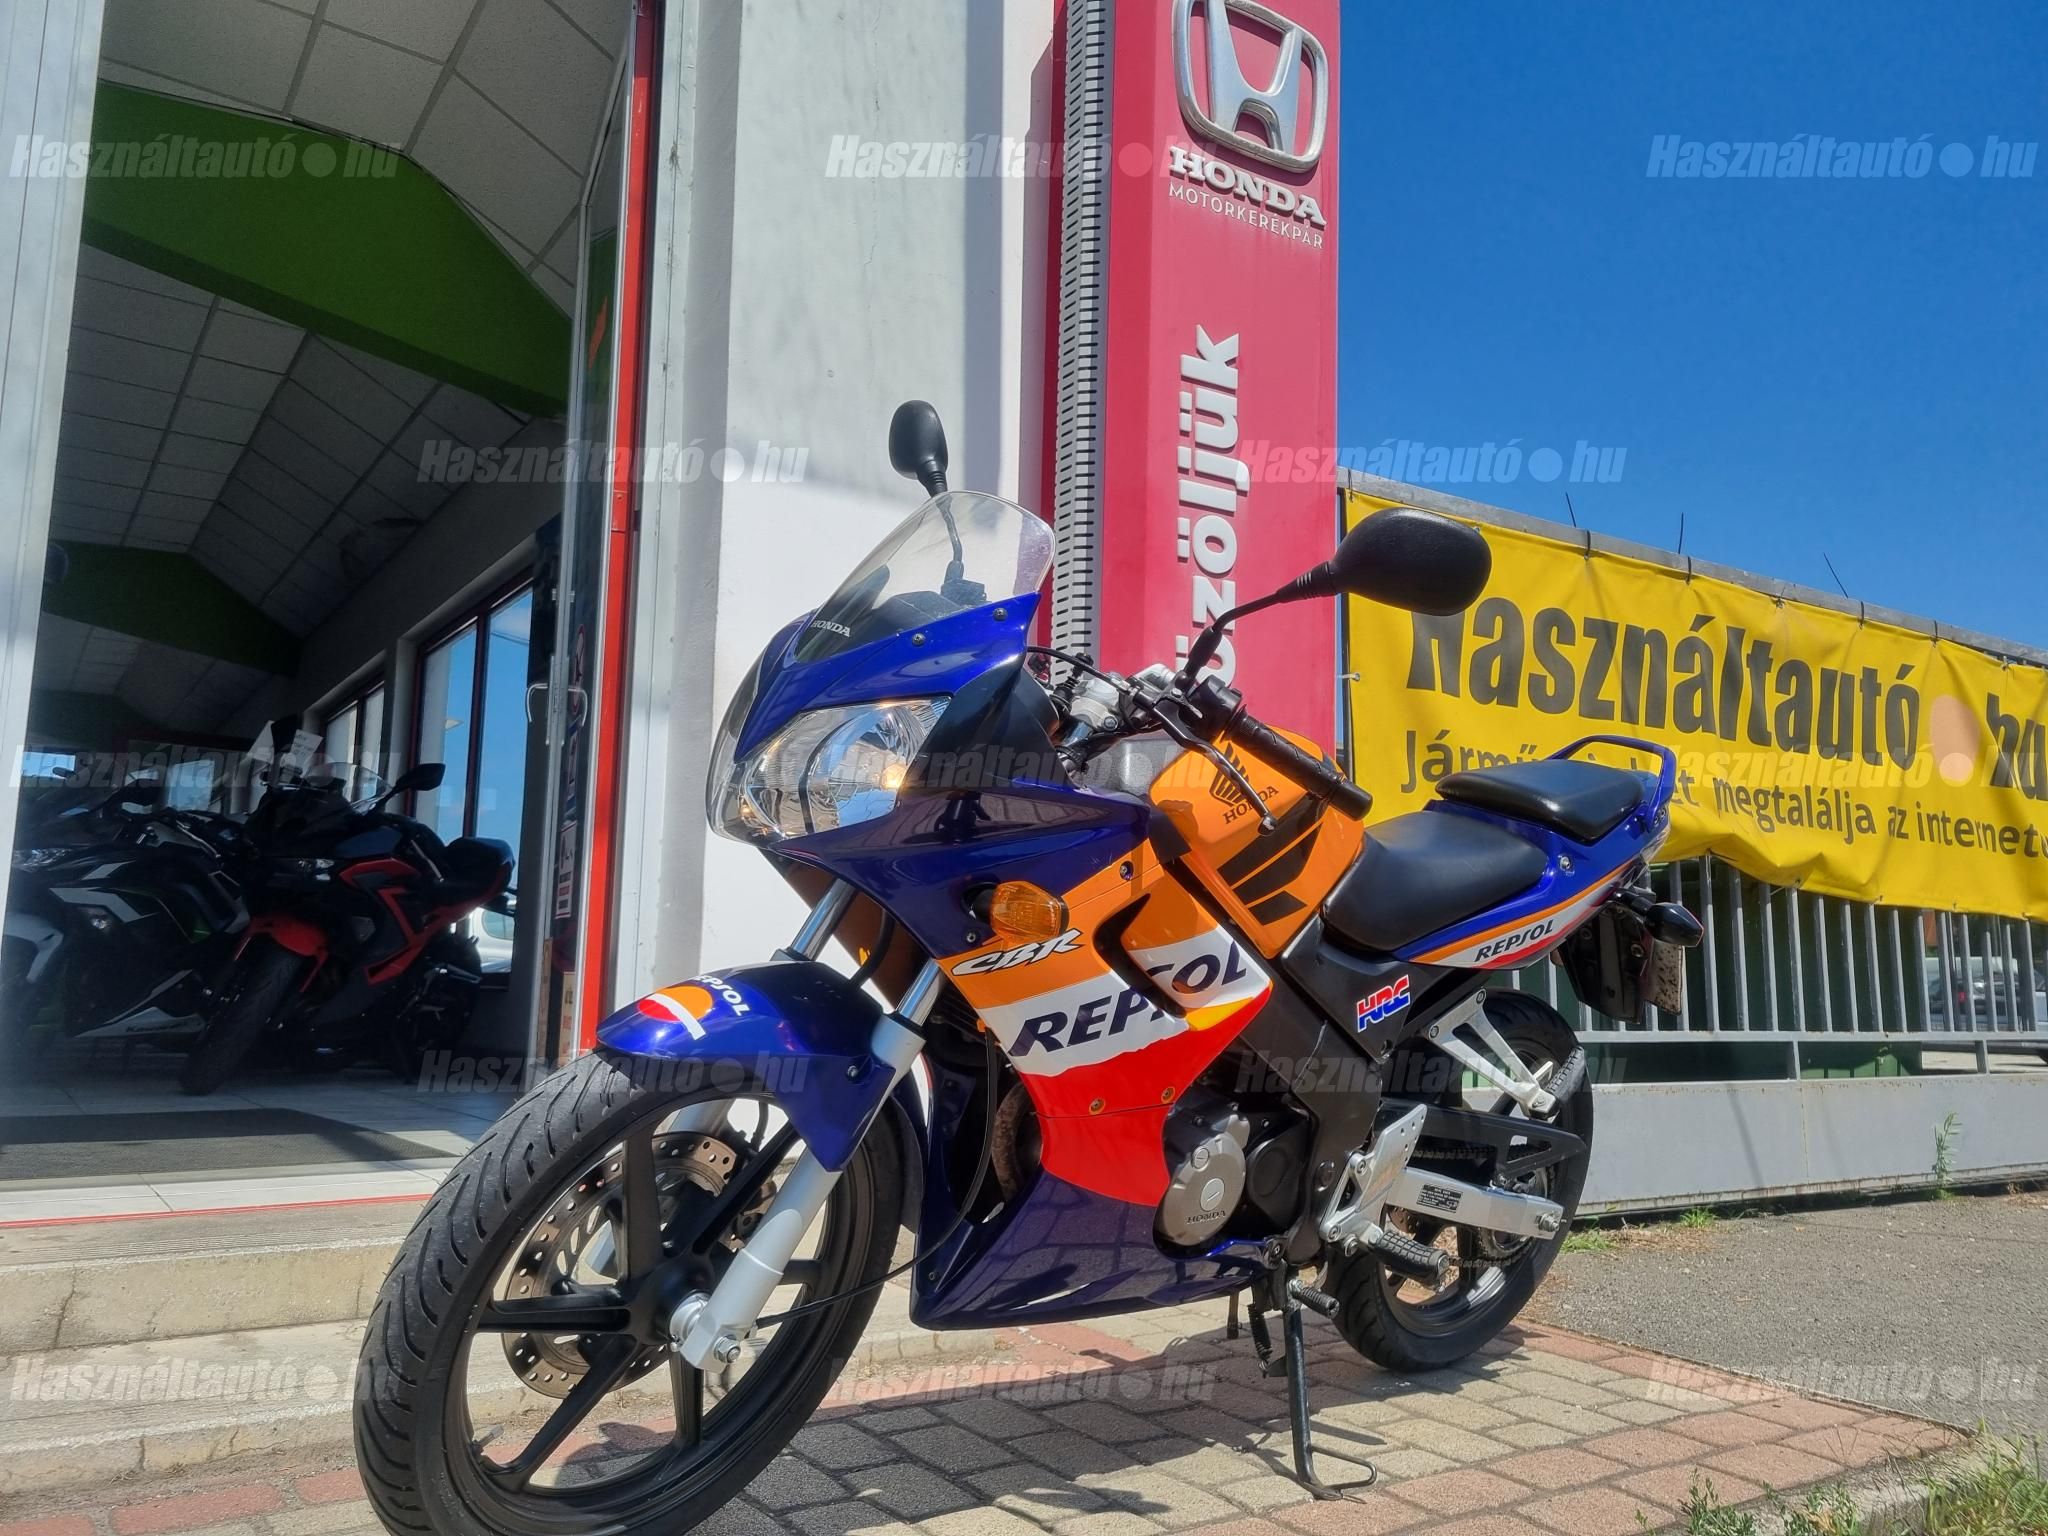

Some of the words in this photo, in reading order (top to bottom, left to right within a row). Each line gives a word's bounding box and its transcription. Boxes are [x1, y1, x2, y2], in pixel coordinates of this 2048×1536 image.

[1168, 146, 1327, 226] HONDA
[1168, 182, 1323, 249] MOTORKERÉKPÁR
[1176, 323, 1251, 688] özöljük
[811, 620, 851, 638] HONDA
[1406, 596, 1920, 771] Használtautó
[1711, 776, 1876, 845] megtalálja
[1887, 804, 1909, 840] az
[952, 927, 1084, 976] CBR
[1474, 919, 1554, 962] REPSOL
[692, 975, 750, 1016] EPSOL
[1356, 974, 1411, 1033] HRC
[1186, 1210, 1227, 1225] HONDA
